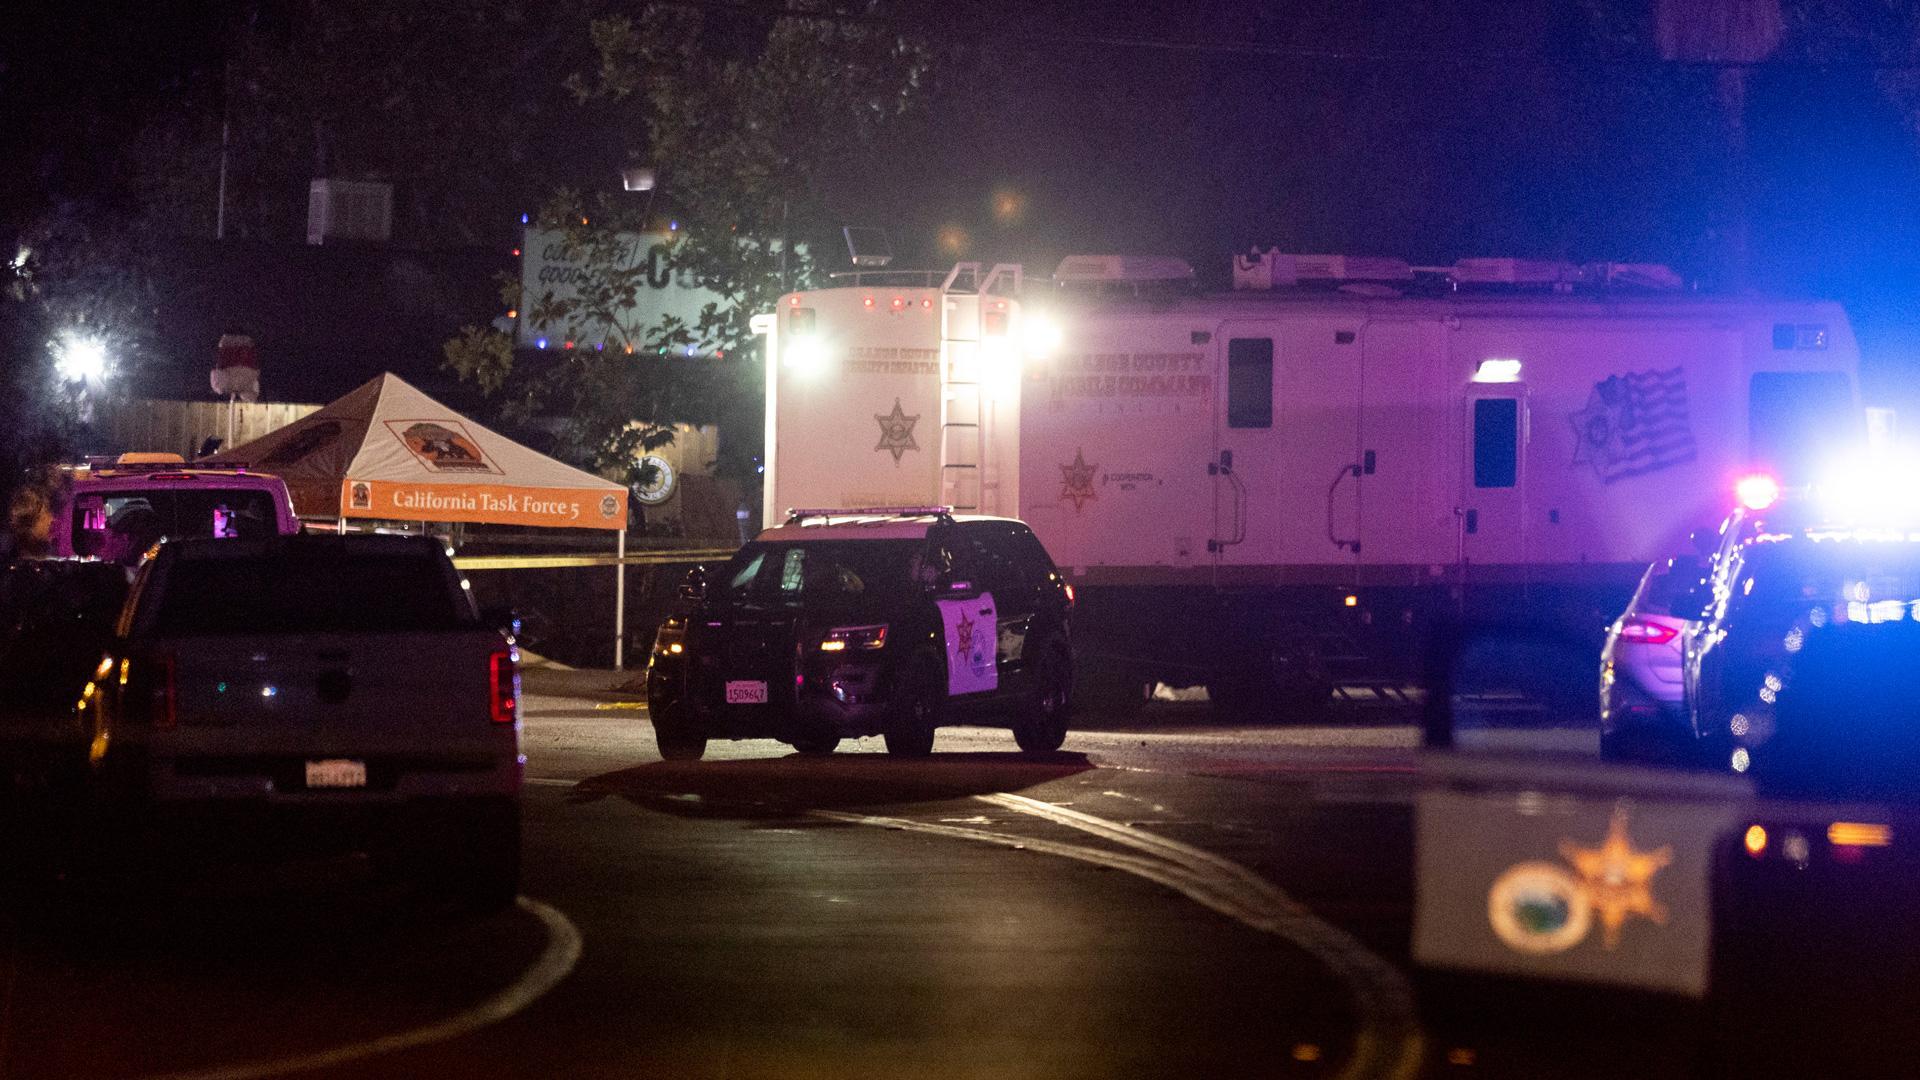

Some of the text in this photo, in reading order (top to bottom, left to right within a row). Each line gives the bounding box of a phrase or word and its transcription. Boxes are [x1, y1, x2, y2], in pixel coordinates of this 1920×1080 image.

[393, 490, 580, 519] California Task Force 5
